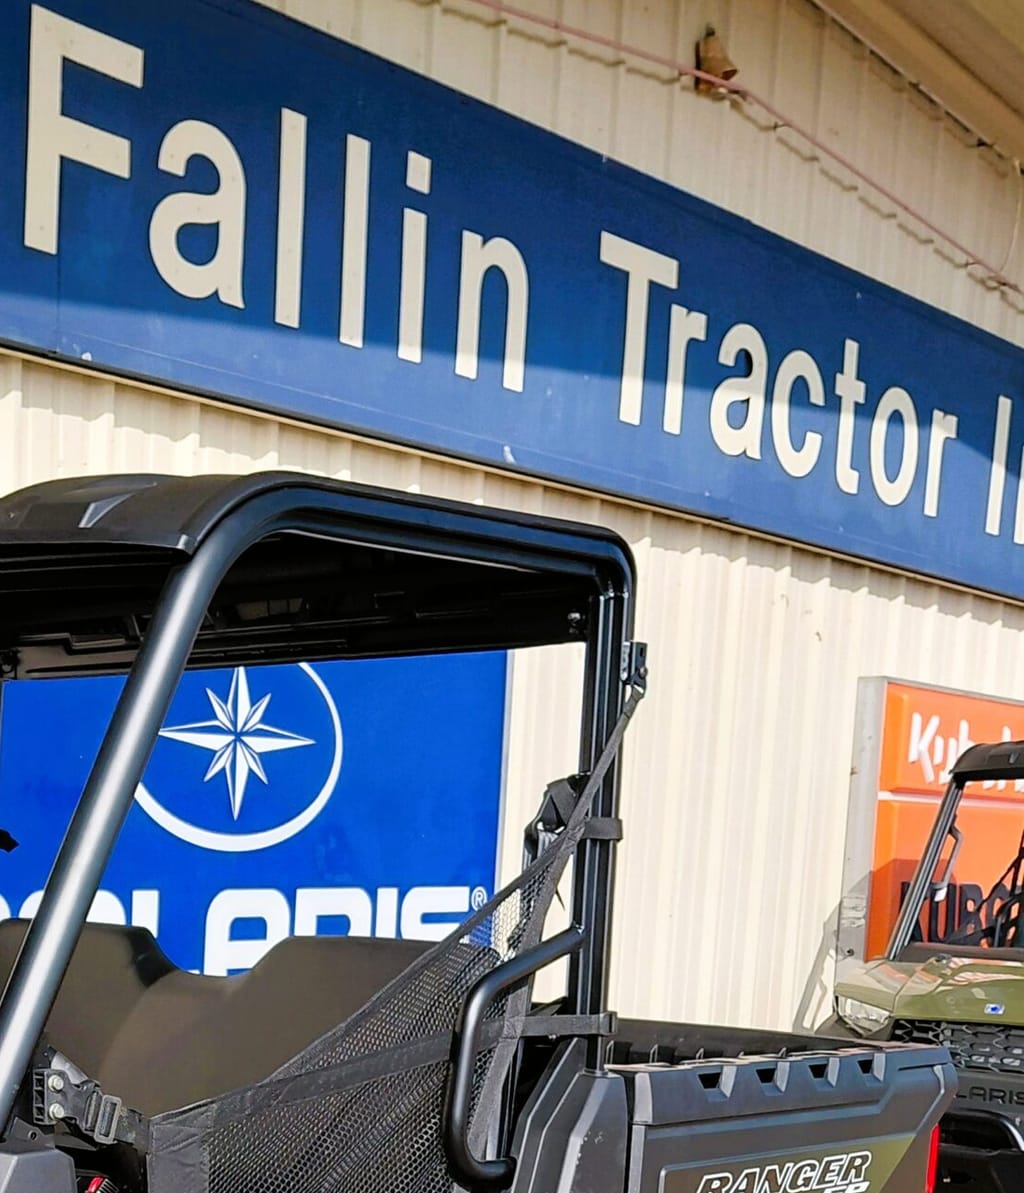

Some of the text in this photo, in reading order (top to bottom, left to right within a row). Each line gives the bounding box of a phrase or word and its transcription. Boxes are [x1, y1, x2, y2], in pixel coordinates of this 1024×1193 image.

[24, 4, 1024, 545] Fallin Tractor I
